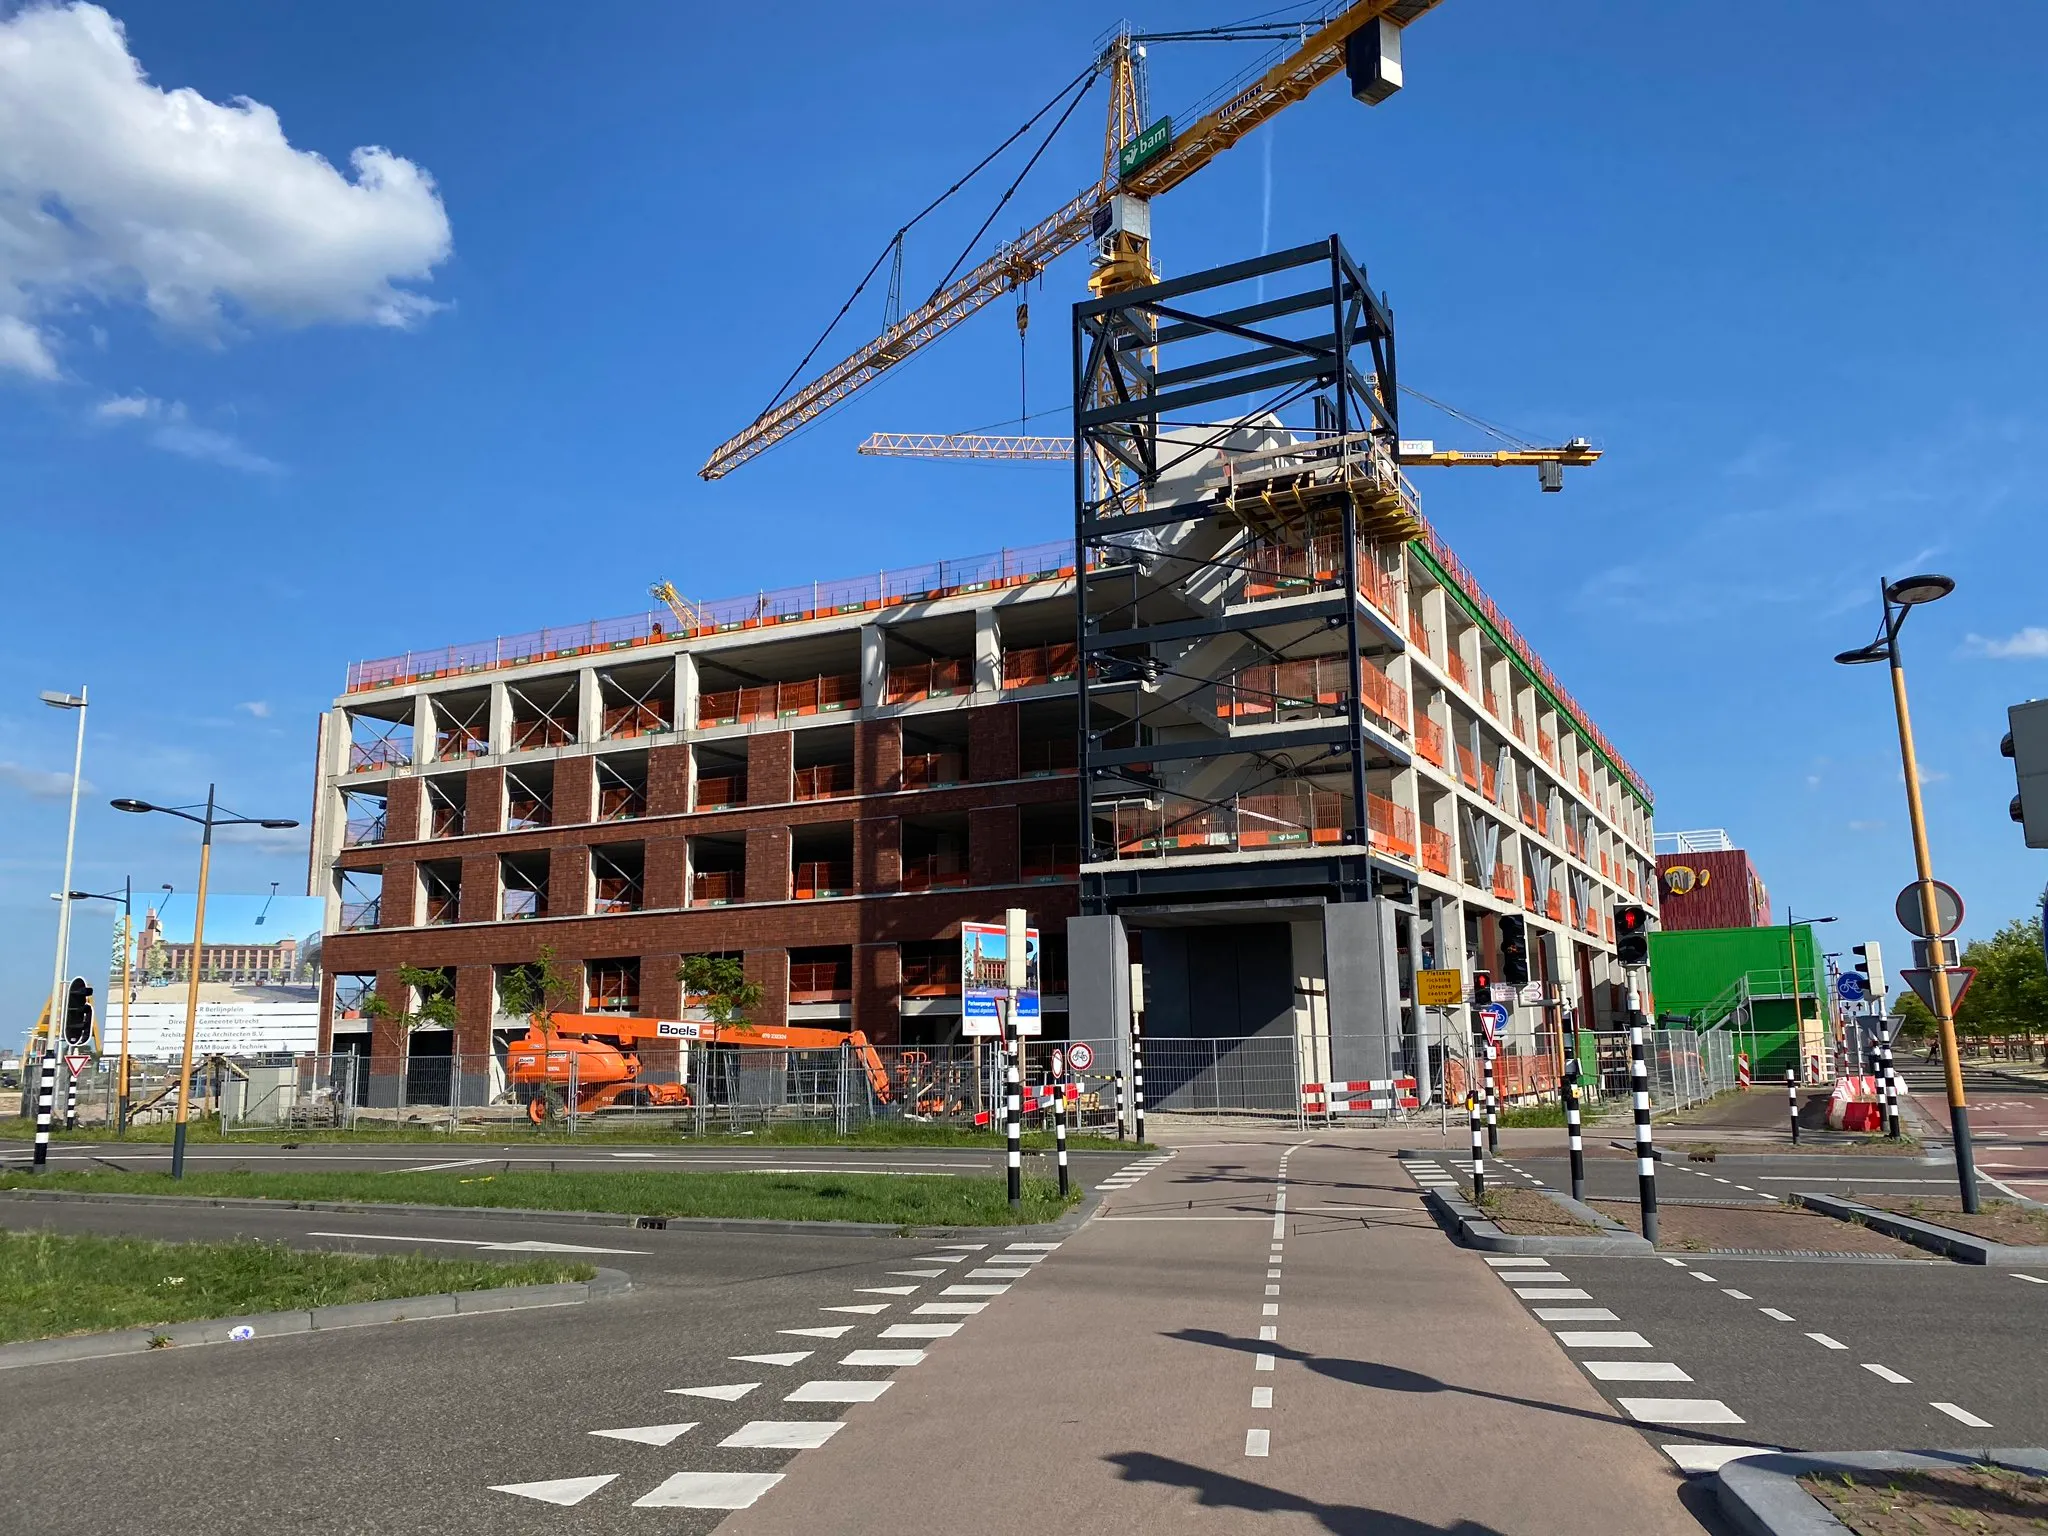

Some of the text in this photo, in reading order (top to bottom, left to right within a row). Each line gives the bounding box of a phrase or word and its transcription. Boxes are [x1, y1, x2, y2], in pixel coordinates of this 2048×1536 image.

[1219, 85, 1262, 119] LIEBHERR
[1139, 127, 1166, 154] bam
[659, 1024, 697, 1036] Boels
